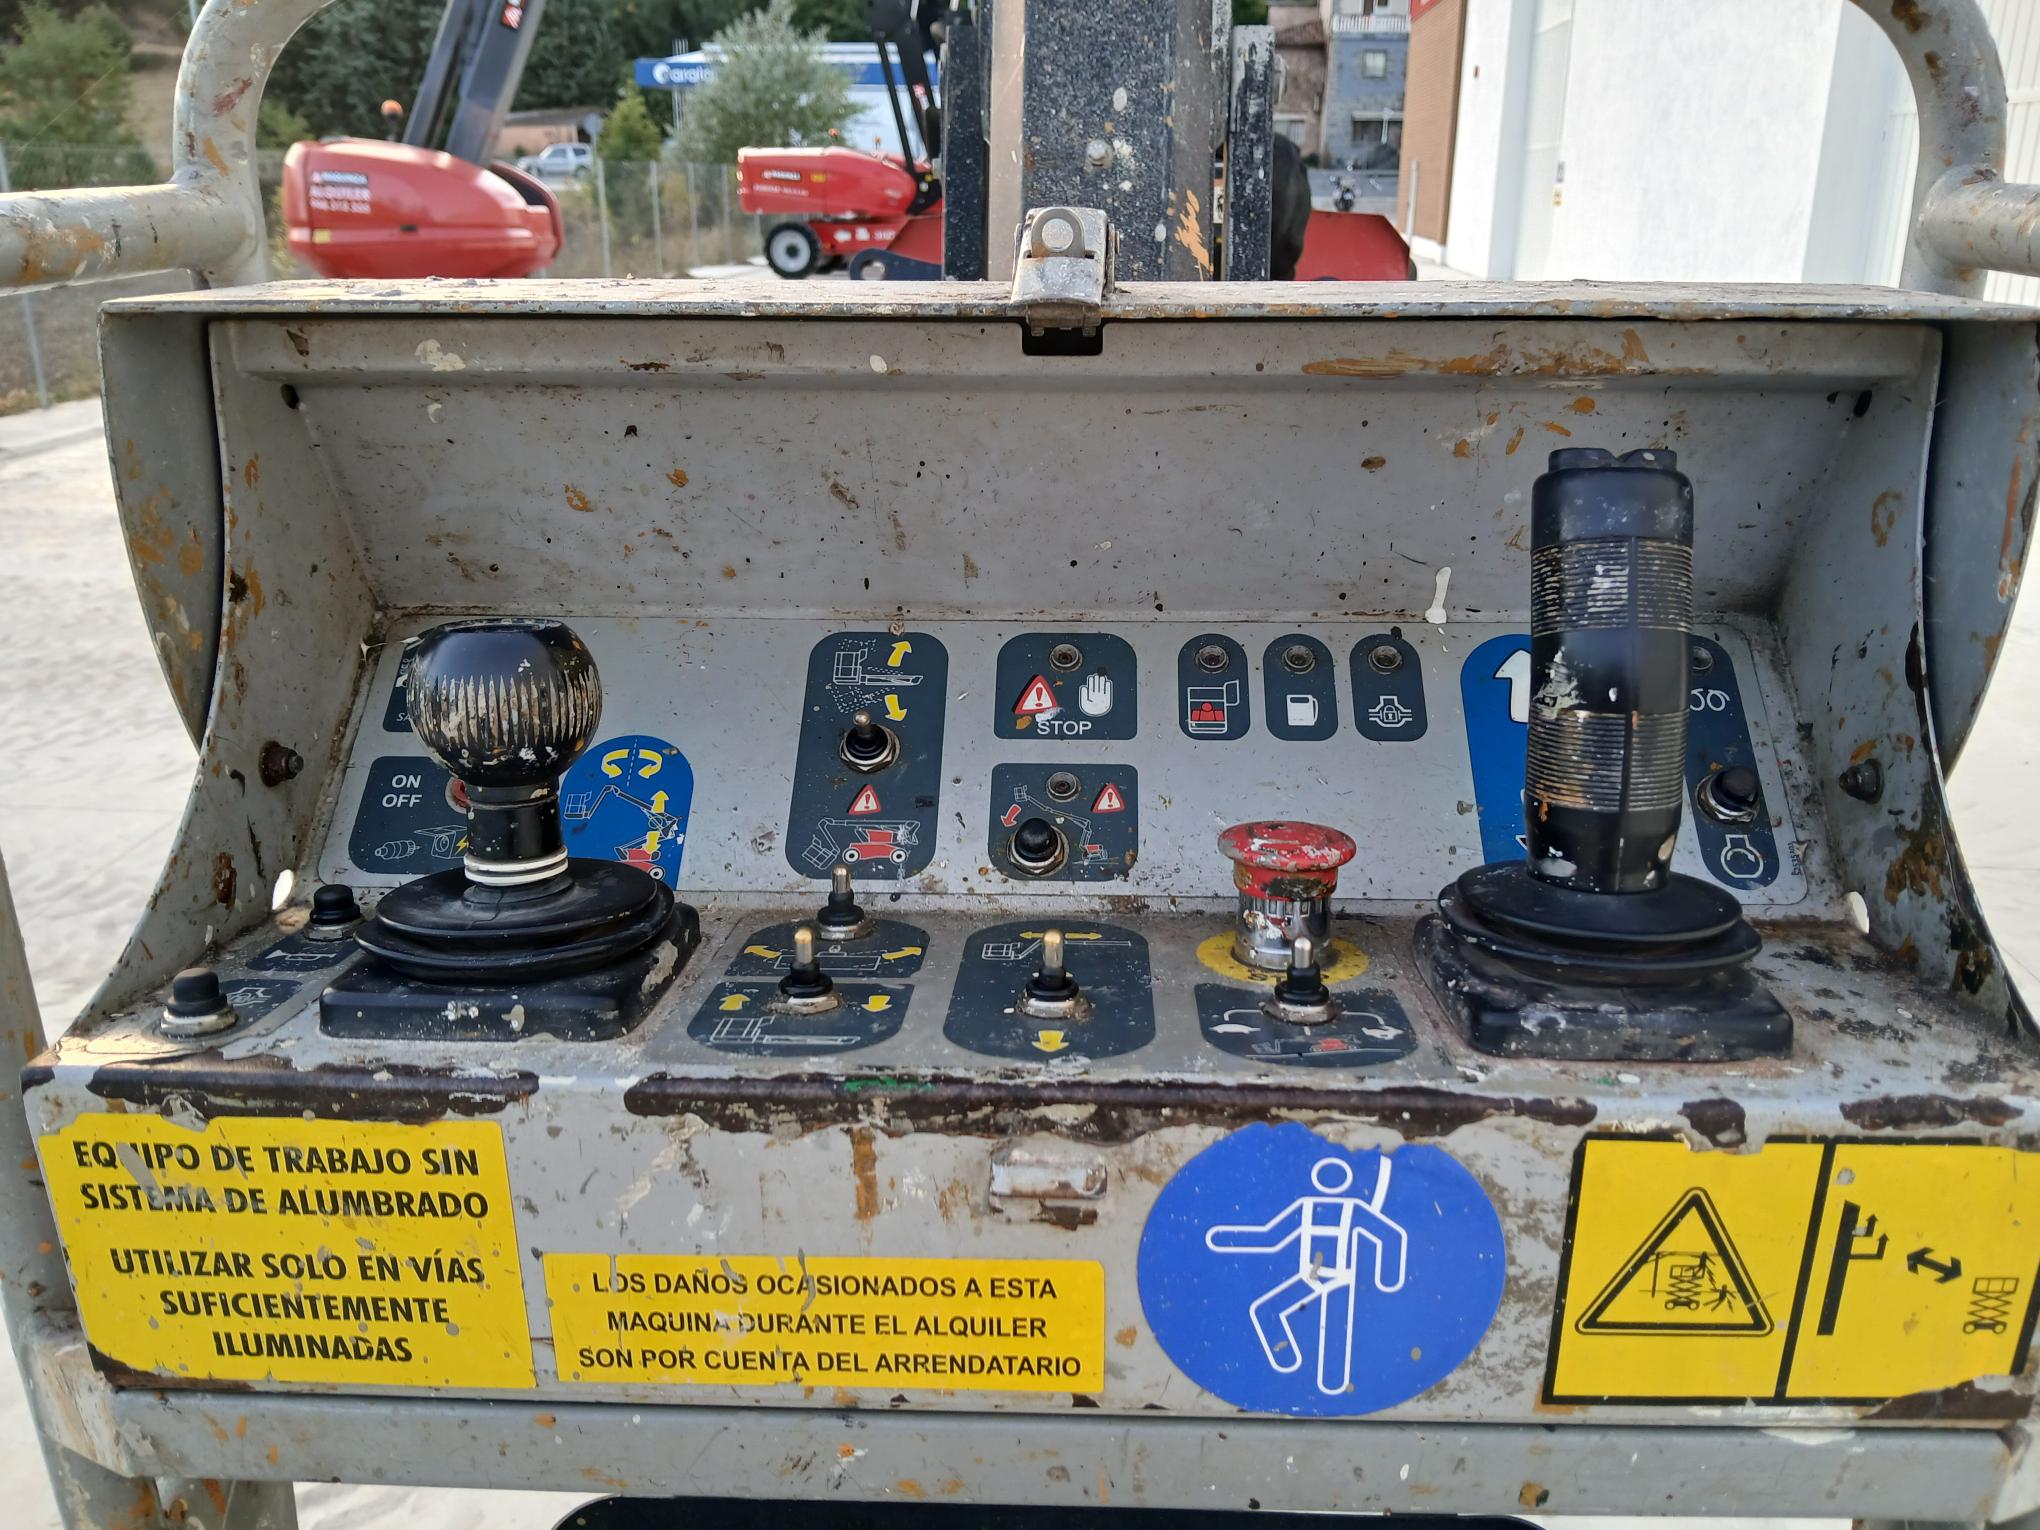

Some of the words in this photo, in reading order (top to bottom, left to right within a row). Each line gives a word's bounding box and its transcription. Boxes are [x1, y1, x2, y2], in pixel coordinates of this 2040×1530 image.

[1037, 720, 1092, 735] STOP
[391, 774, 422, 788] ON
[382, 793, 422, 808] OFF
[210, 1143, 255, 1172] DE
[262, 1146, 411, 1175] TRABAJO
[422, 1148, 479, 1176] SIN
[223, 1187, 268, 1214] DE
[279, 1188, 488, 1218] ALUMBRADO
[110, 1248, 254, 1278] UTILIZAR
[261, 1253, 347, 1280] SOLO
[357, 1255, 401, 1282] EN
[407, 1248, 485, 1284] VÍAS
[592, 1272, 646, 1293] LOS
[655, 1269, 748, 1295] DAÑOS
[757, 1275, 956, 1297] OCASIONADOS
[964, 1277, 983, 1298] A
[990, 1277, 1057, 1299] ESTA
[160, 1289, 450, 1323] SUFICIENTEMENTE
[607, 1311, 731, 1333] MAQUINA
[738, 1312, 866, 1334] DURANTE
[874, 1314, 907, 1335] EL
[914, 1316, 1047, 1338] ALQUILER
[212, 1331, 413, 1362] ILUMINADAS
[579, 1348, 633, 1369] SON
[641, 1349, 697, 1370] POR
[704, 1350, 810, 1372] CUENTA
[817, 1351, 868, 1373] DEL
[875, 1353, 1081, 1377] ARRENDATARIO
